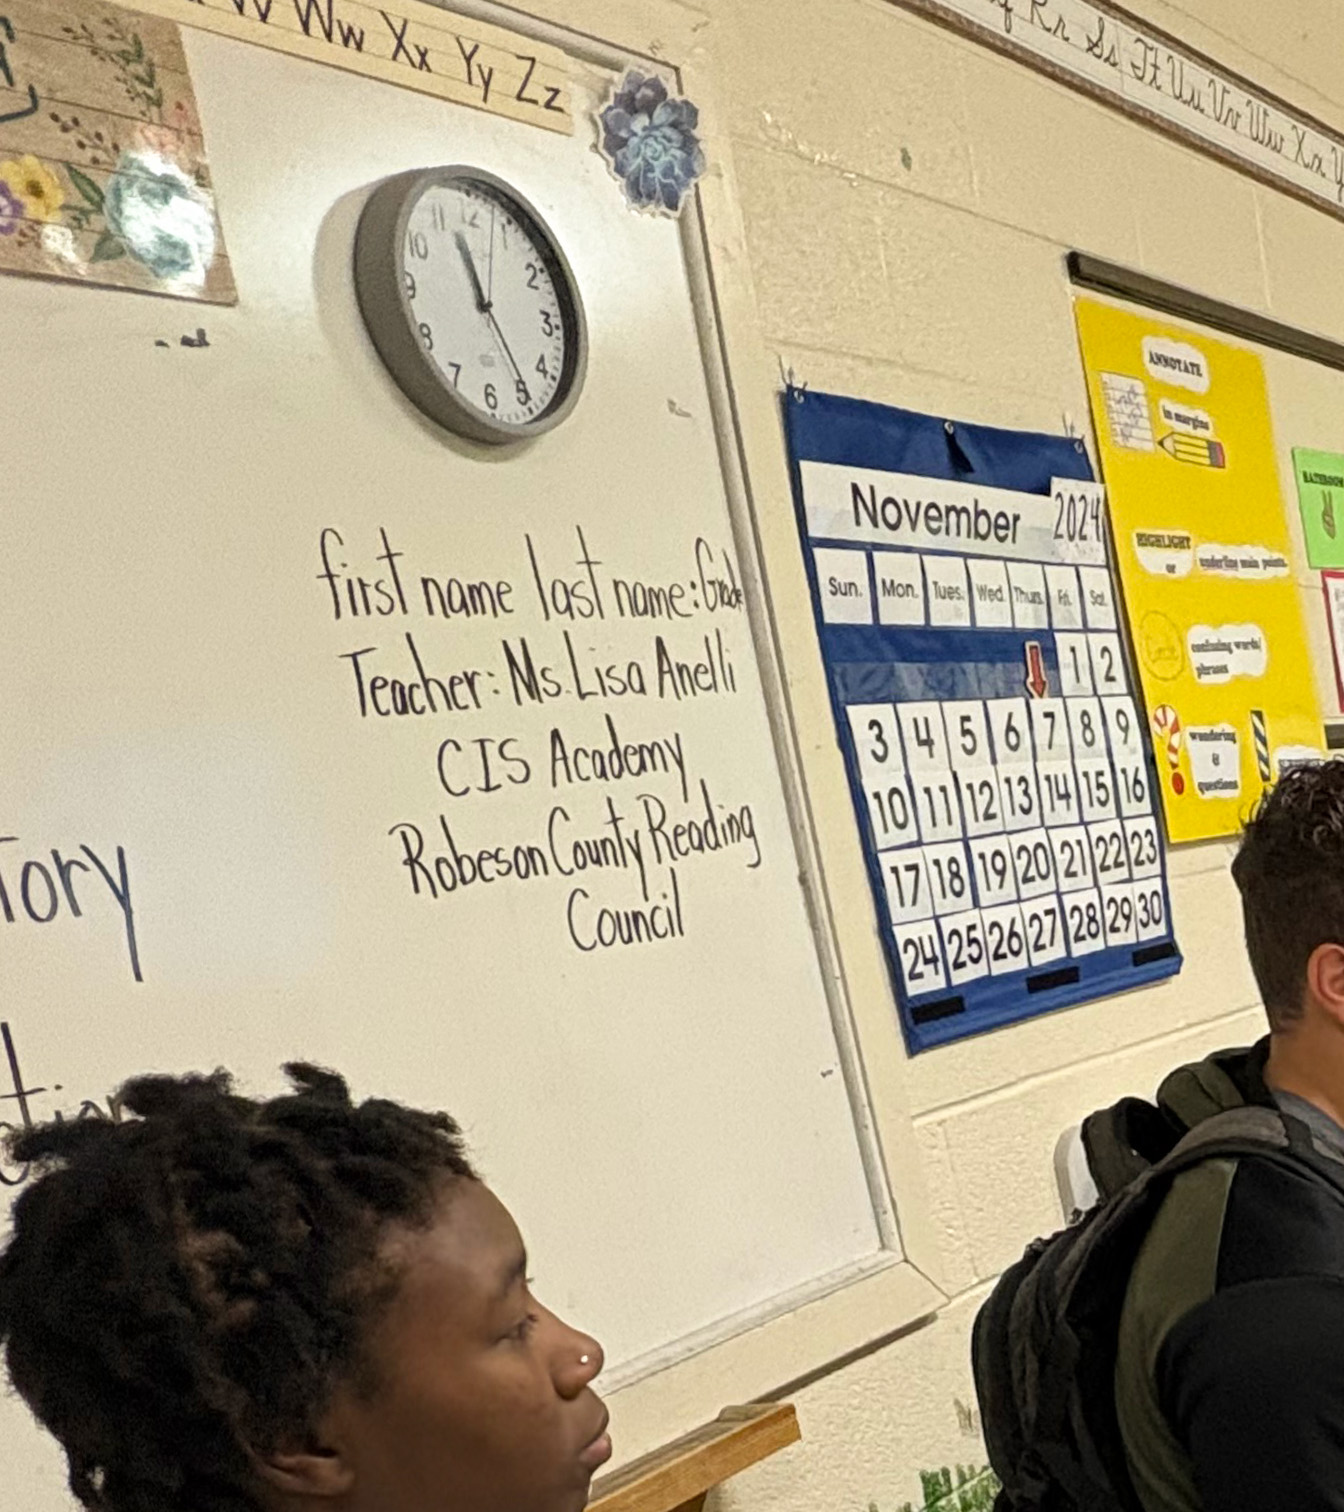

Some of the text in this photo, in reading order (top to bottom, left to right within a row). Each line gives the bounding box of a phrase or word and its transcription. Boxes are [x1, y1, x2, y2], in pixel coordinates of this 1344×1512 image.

[380, 10, 432, 73] Xx
[456, 35, 493, 103] Yy
[516, 54, 566, 113] Zz
[1086, 15, 1119, 68] Ss
[1129, 36, 1161, 91] Tt
[1166, 54, 1204, 114] Uu
[1208, 78, 1242, 131] Vv
[432, 202, 446, 232] 11
[407, 230, 430, 261] 10
[404, 269, 417, 300] 9
[524, 262, 541, 291] 2
[418, 322, 434, 351] 8
[539, 308, 554, 338] 3
[448, 361, 462, 389] 7
[535, 353, 549, 380] 4
[483, 382, 499, 411] 6
[515, 377, 530, 407] 5
[850, 480, 1102, 545] November 2024
[316, 526, 409, 621] first
[421, 575, 516, 619] name
[524, 525, 605, 621] last
[612, 577, 701, 620] name:
[827, 576, 864, 599] Sun.
[880, 577, 920, 600] Mon.
[932, 580, 966, 602] Tues.
[339, 631, 501, 717] Teacher:
[563, 630, 646, 701] Lisa
[655, 628, 738, 701] Anelli
[1069, 645, 1117, 684] 1 2
[437, 713, 690, 803] CIS Academy
[867, 707, 1130, 764] 3 4 5 6 7 8 9
[872, 766, 1146, 834] 10 11 12 13 14 15 16
[387, 778, 763, 902] Robeson County Reading
[889, 828, 1158, 909] 17 18 19 20 21 22 23
[566, 866, 685, 952] Council
[902, 889, 1164, 983] 24 25 26 27 28 29 30
